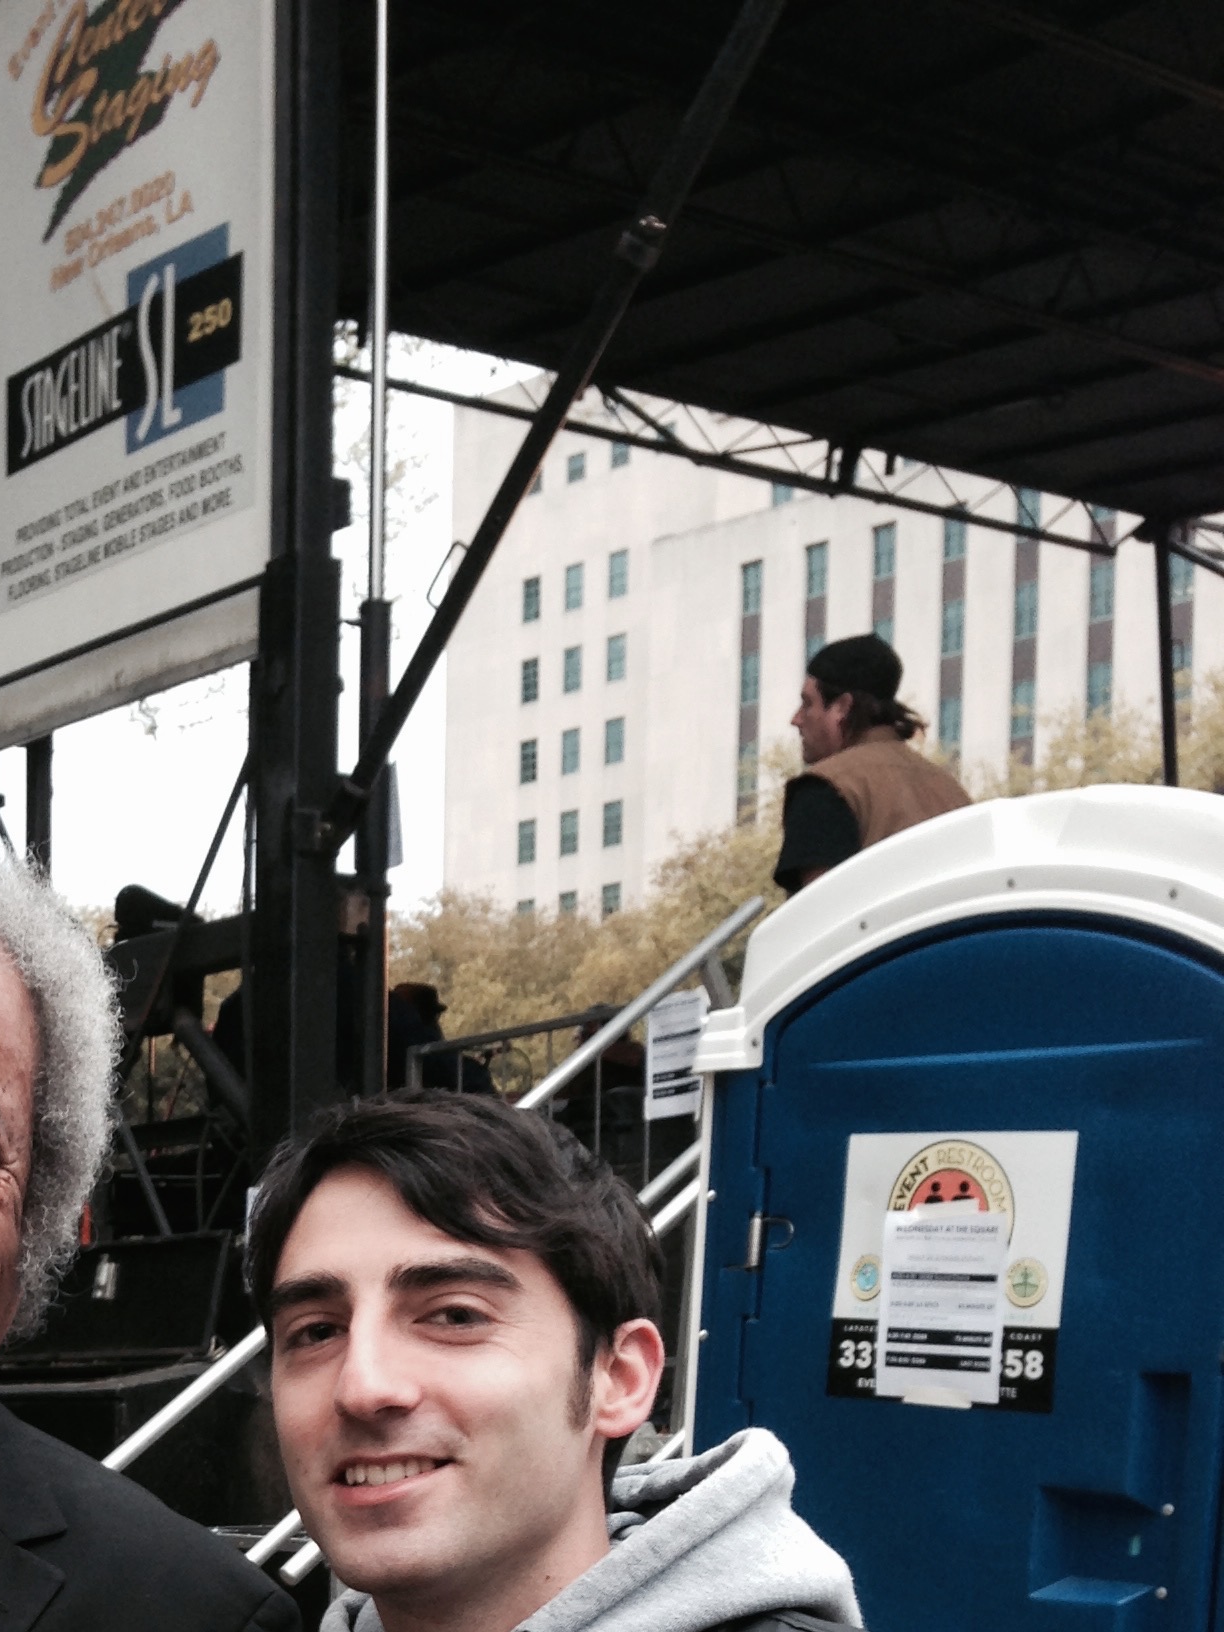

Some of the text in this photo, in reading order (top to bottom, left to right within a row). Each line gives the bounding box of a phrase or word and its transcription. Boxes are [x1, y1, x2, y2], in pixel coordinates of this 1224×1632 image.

[37, 38, 221, 189] Staging
[165, 189, 194, 225] LA
[21, 262, 234, 459] STAGELINE SL 250
[92, 480, 122, 509] EVENT
[123, 470, 145, 494] AND
[144, 430, 226, 484] ENTERTAINMENT
[1, 541, 55, 577] PRODUCTION
[169, 473, 197, 500] FOOD
[179, 501, 199, 524] AND
[893, 1147, 1007, 1213] EVENT RESTROOM
[839, 1339, 876, 1369] 33
[1009, 1332, 1043, 1341] COAST
